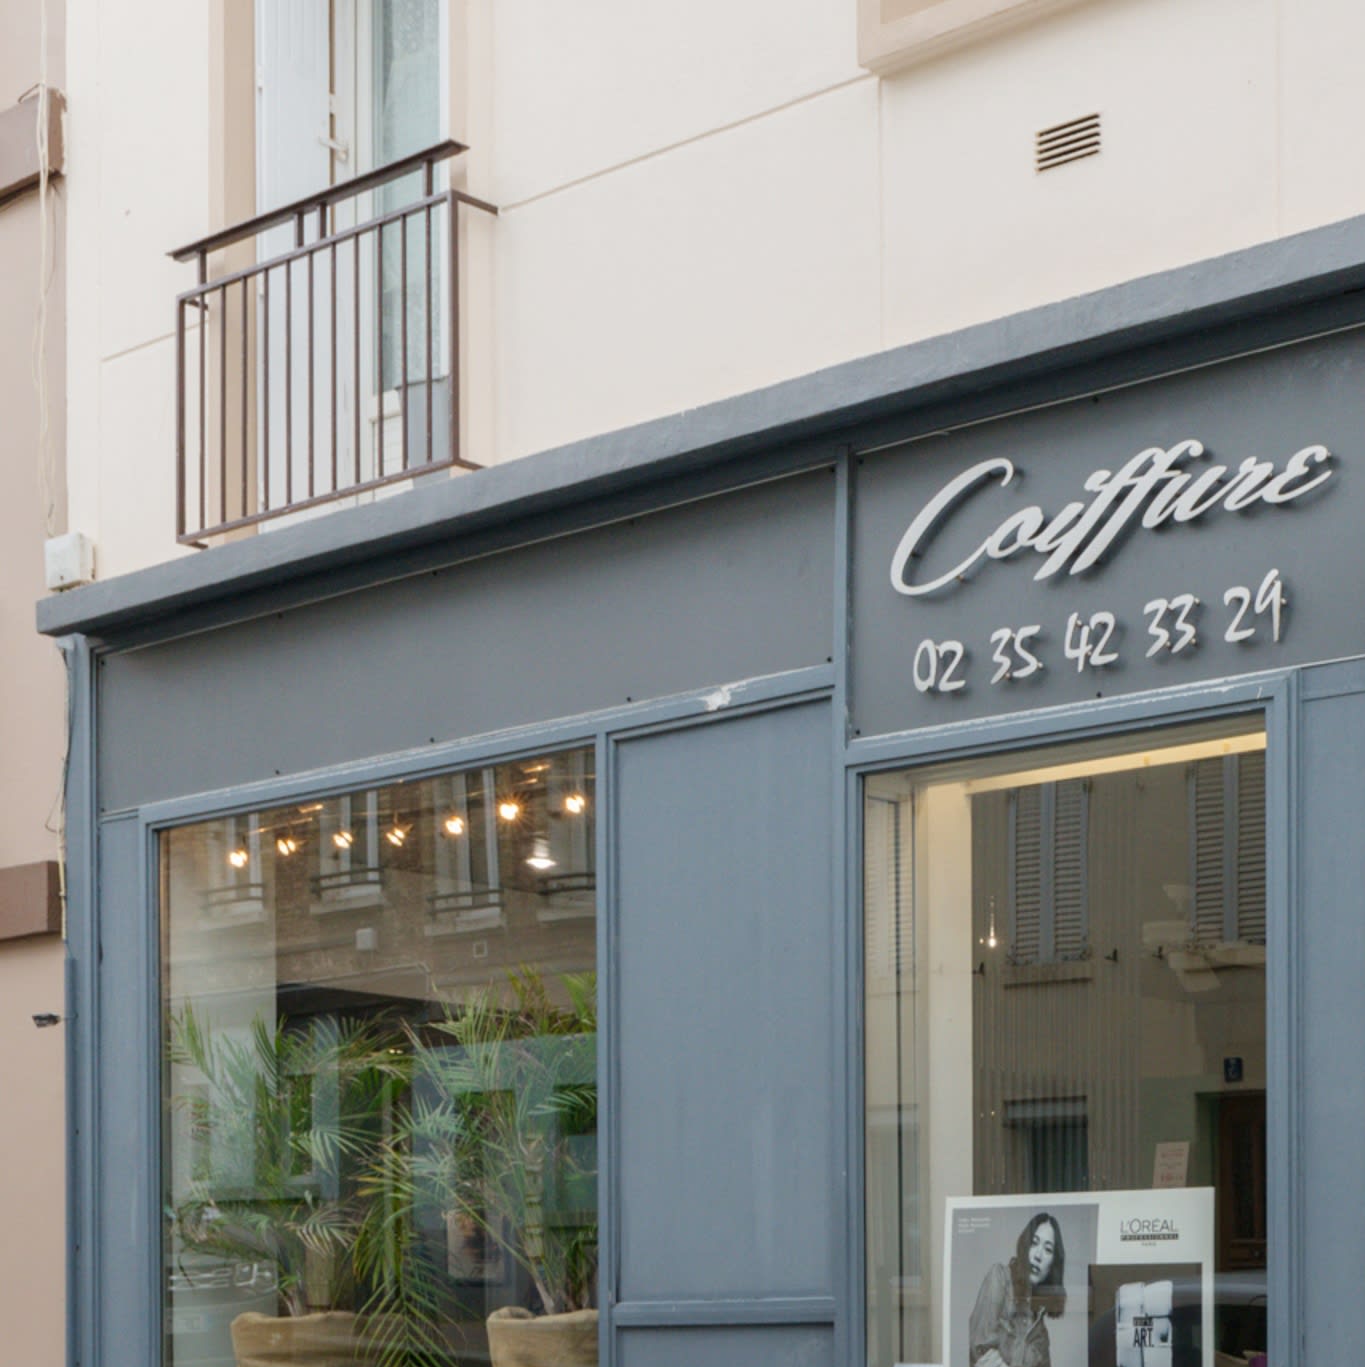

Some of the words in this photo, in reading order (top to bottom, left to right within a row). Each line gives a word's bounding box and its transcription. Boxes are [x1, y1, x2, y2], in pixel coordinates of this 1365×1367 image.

[889, 439, 1333, 596] Coiffure
[912, 638, 966, 692] 02
[989, 624, 1043, 684] 35
[1064, 611, 1119, 673] 42
[1143, 593, 1200, 658] 33
[1223, 568, 1282, 643] 29
